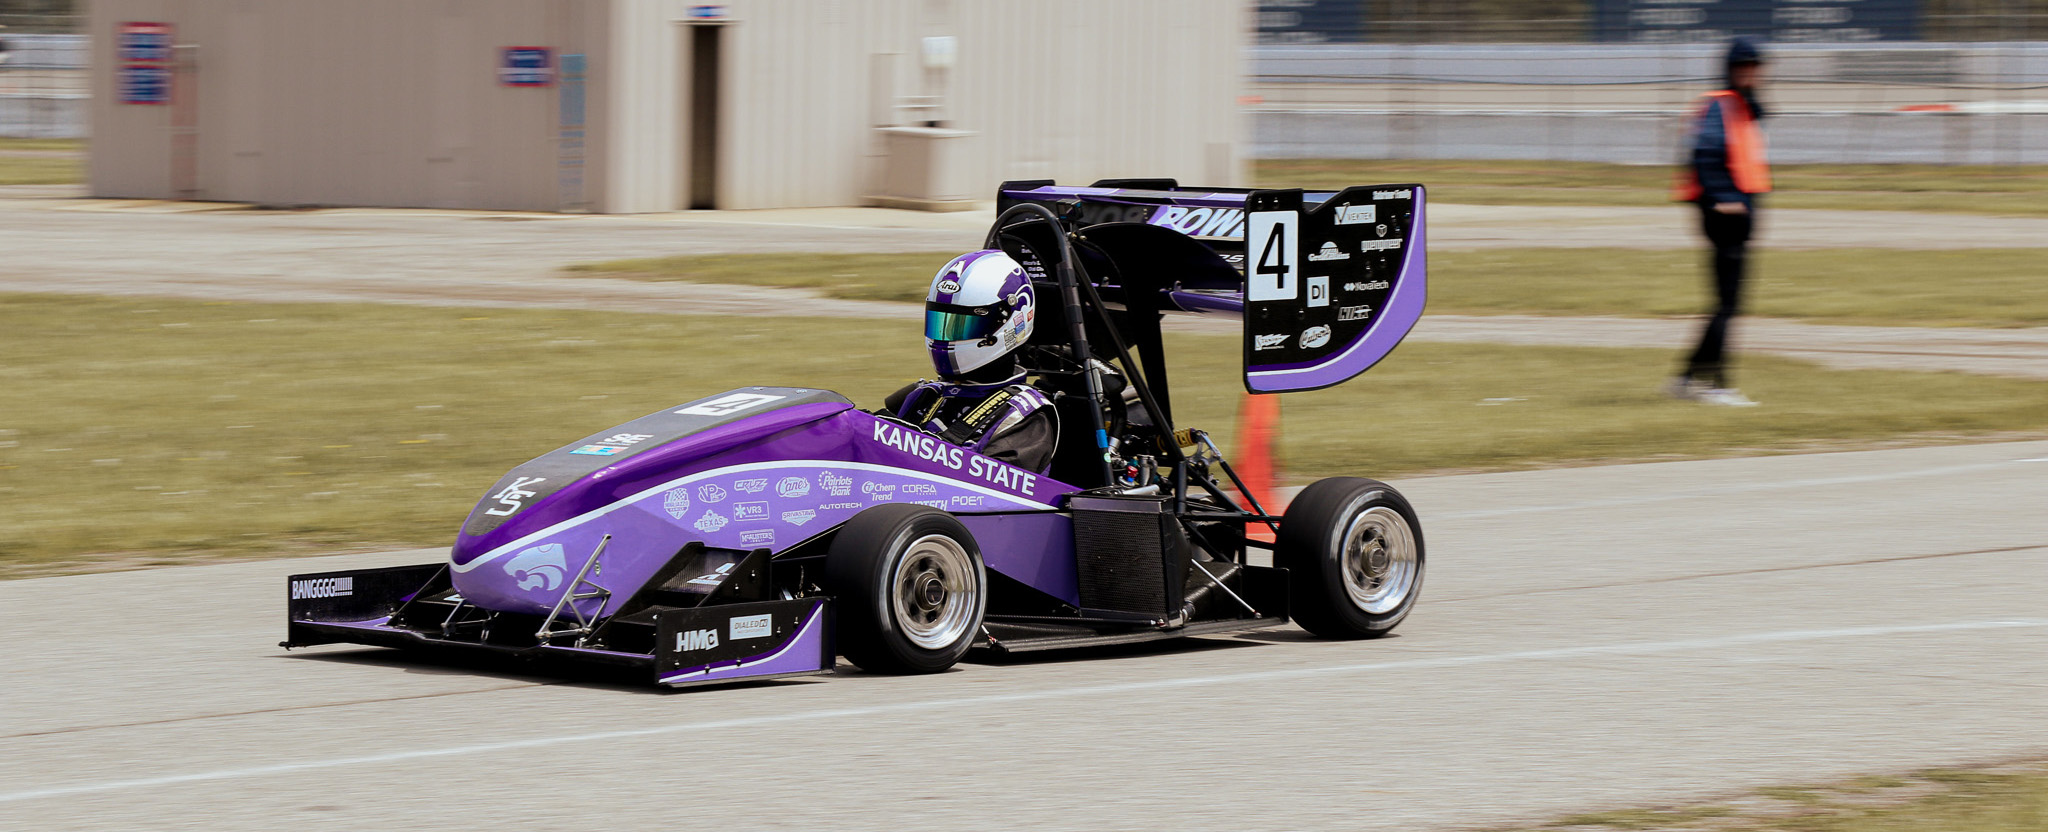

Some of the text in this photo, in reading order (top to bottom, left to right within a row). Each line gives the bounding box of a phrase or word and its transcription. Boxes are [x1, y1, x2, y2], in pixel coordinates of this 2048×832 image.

[1256, 222, 1290, 289] 4
[1311, 284, 1325, 300] DI
[873, 421, 1037, 496] KANSAS STATE
[778, 476, 808, 497] Cane's
[823, 475, 853, 487] Patriots
[831, 486, 851, 497] Bank
[874, 482, 896, 492] Chem
[902, 484, 937, 493] CORSA
[871, 492, 893, 502] Trend
[951, 496, 985, 506] POET
[747, 506, 762, 514] VR3
[819, 502, 863, 510] AUTOTECH
[700, 517, 724, 528] TEXAS
